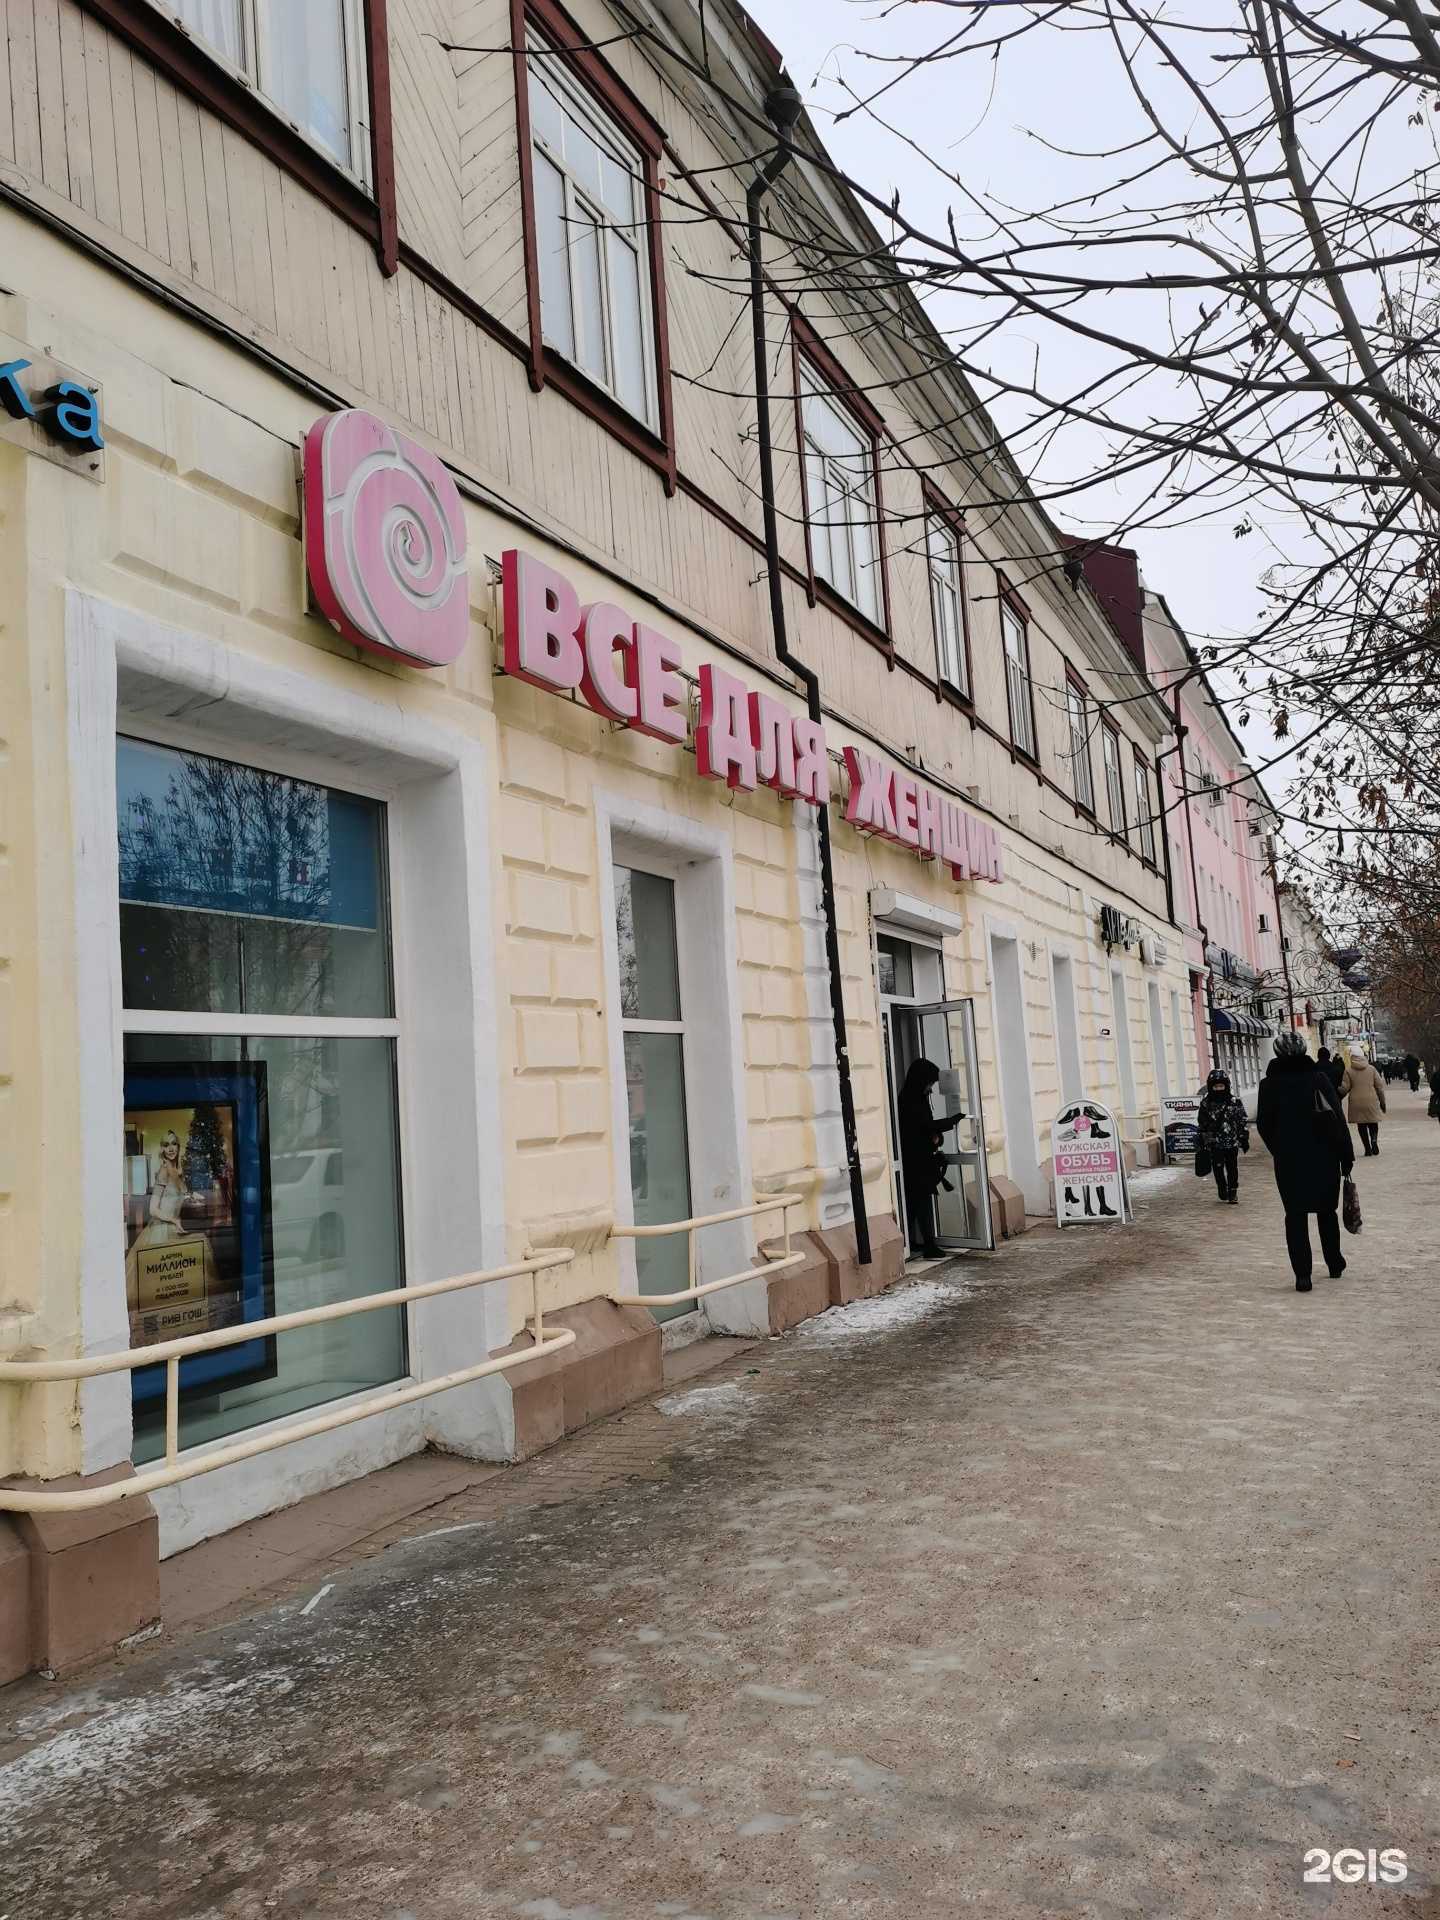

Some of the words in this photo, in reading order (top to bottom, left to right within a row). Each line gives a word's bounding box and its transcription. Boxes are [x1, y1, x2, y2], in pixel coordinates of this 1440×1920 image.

[502, 549, 688, 744] ВСЕ
[696, 663, 829, 805] ДЛЯ
[843, 746, 1004, 884] ЖЕНЩИН
[1059, 1141, 1111, 1153] МУЖСКАЯ
[1061, 1154, 1111, 1167] ОБУВЬ
[1062, 1175, 1114, 1185] ЖЕНСКАЯ
[146, 1257, 197, 1274] МИЛЛИОН
[160, 1271, 184, 1282] РУБЛЕЙ
[162, 1312, 181, 1325] РИВ
[182, 1308, 202, 1321] ГОШ
